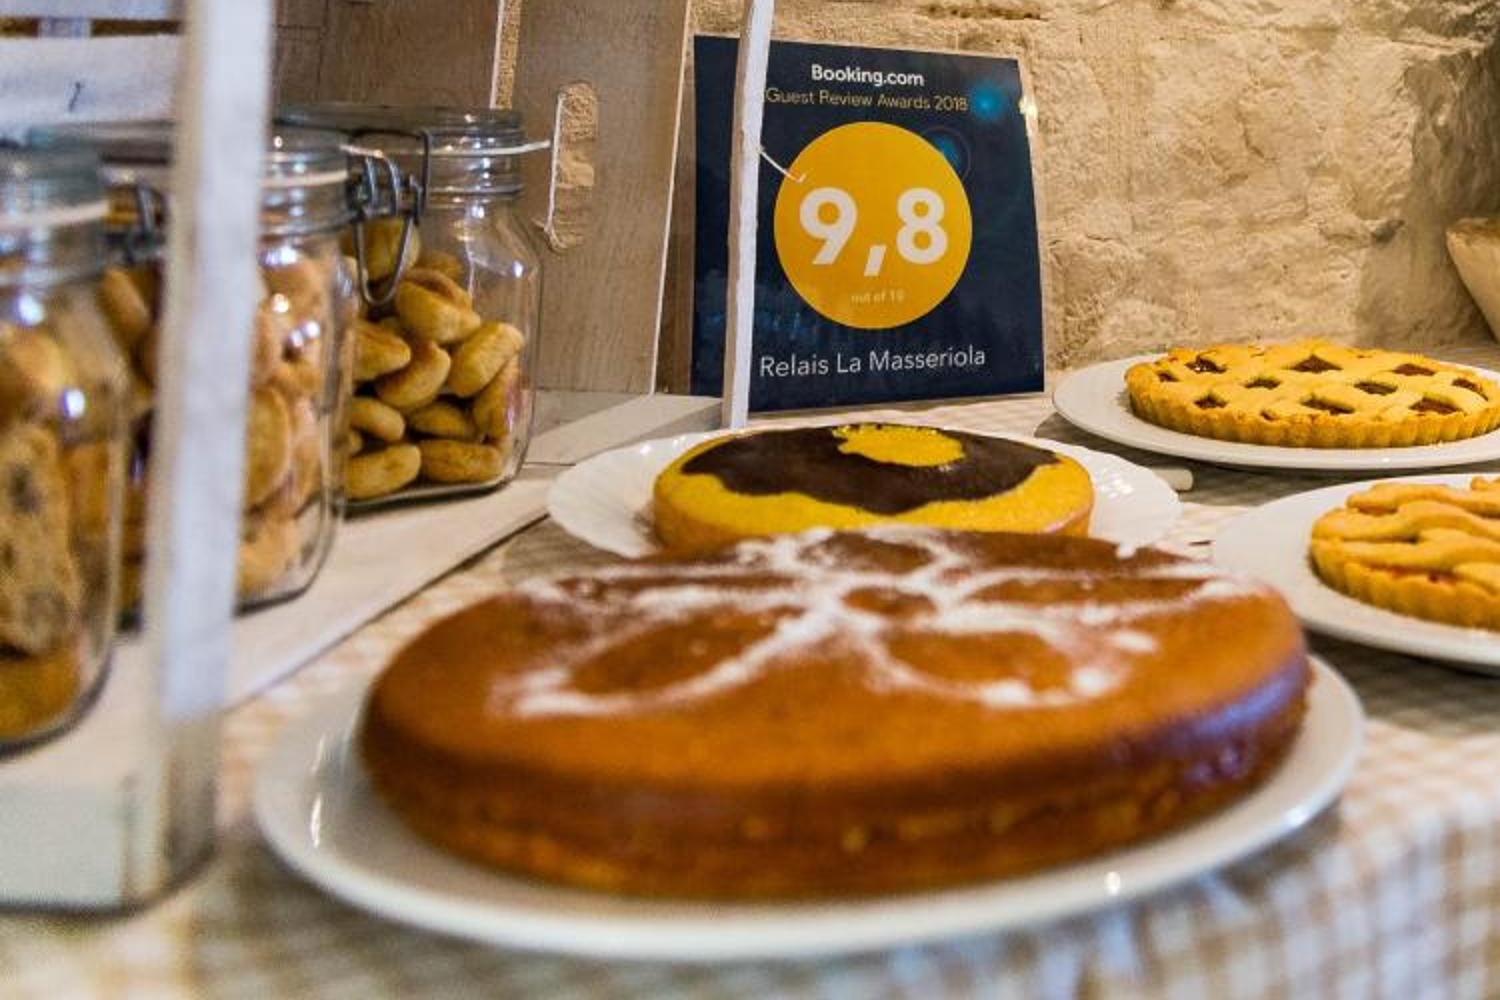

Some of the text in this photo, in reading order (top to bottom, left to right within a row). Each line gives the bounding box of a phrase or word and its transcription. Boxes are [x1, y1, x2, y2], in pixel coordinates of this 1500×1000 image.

[811, 64, 925, 87] Booking.com
[765, 87, 815, 105] Guest
[819, 89, 873, 107] Review
[877, 93, 930, 110] Awards
[800, 186, 949, 277] 9,8
[759, 344, 987, 378] Relais La Masseriola
